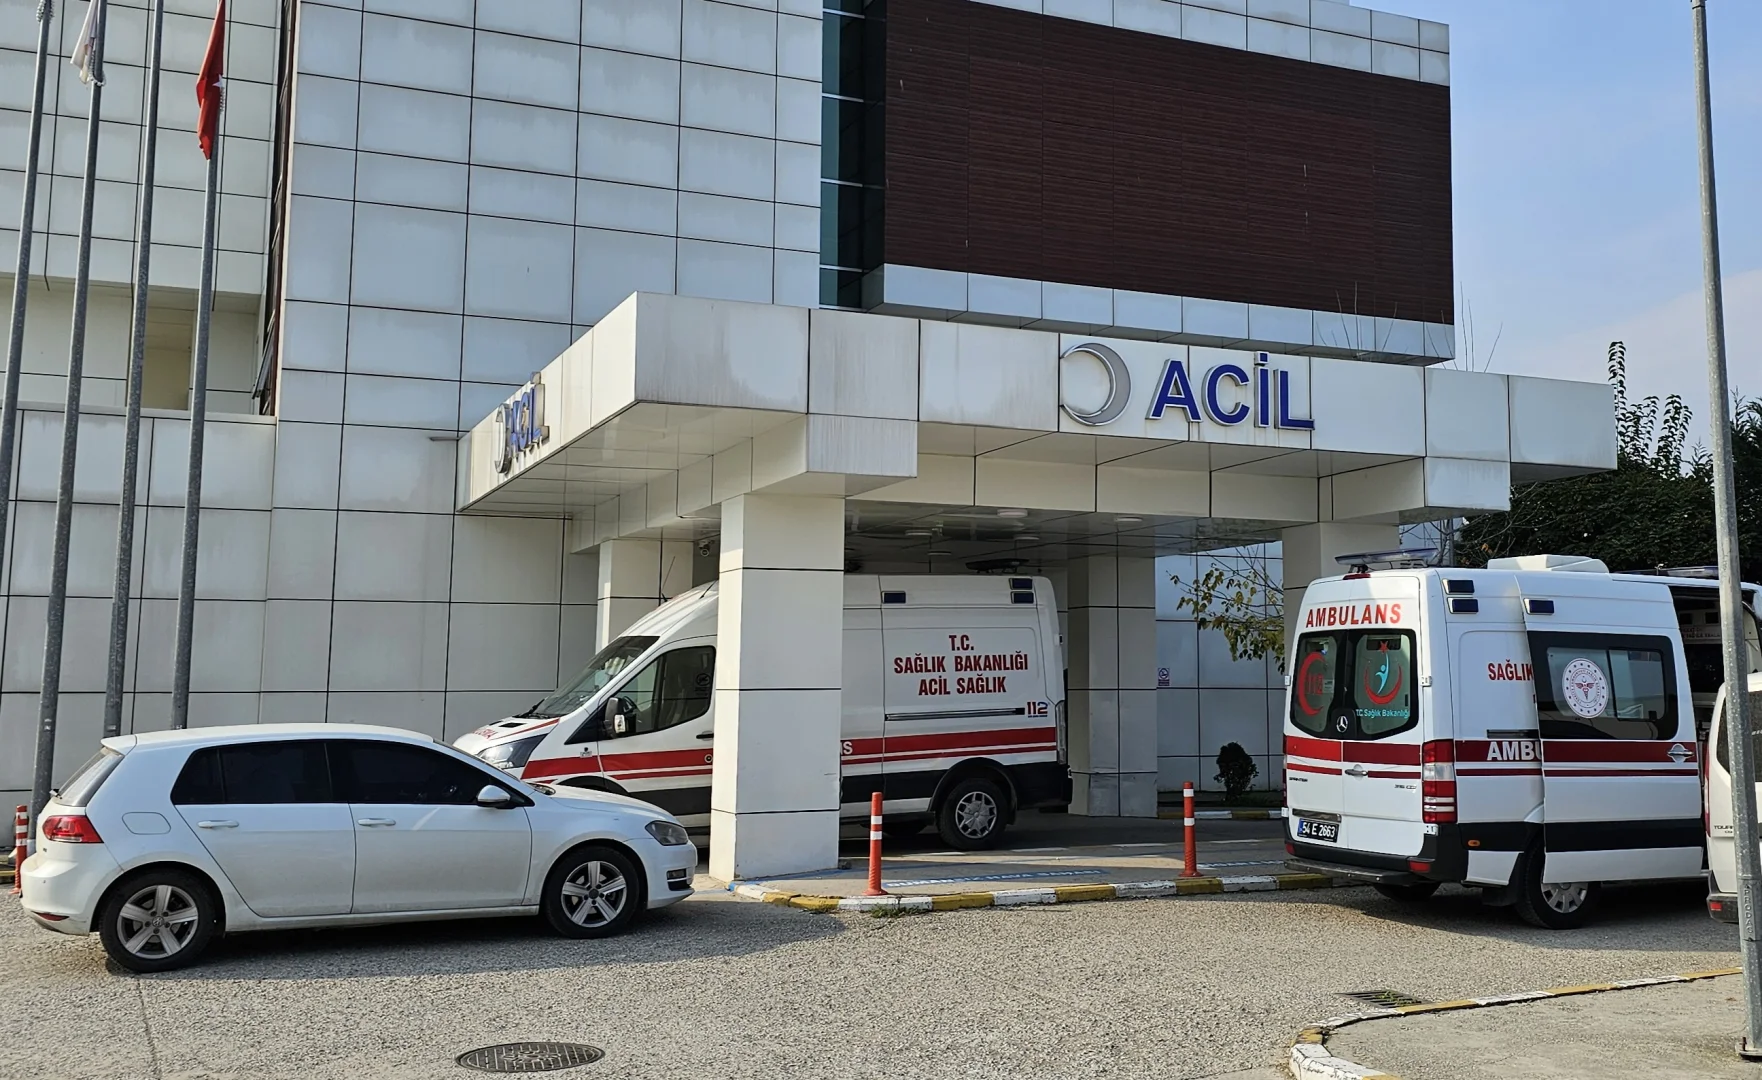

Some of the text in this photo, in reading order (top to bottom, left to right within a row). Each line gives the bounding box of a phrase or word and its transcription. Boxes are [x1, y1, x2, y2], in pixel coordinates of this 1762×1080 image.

[1145, 351, 1315, 430] ACİL
[1305, 603, 1402, 628] AMBULANS
[949, 634, 974, 651] T.C.
[894, 650, 1028, 674] SAĞLIK BAKANLIĞI
[918, 673, 1007, 696] ACİL SAĞLIK
[1026, 701, 1048, 715] 112
[1302, 821, 1311, 835] 54
[1311, 823, 1319, 836] E
